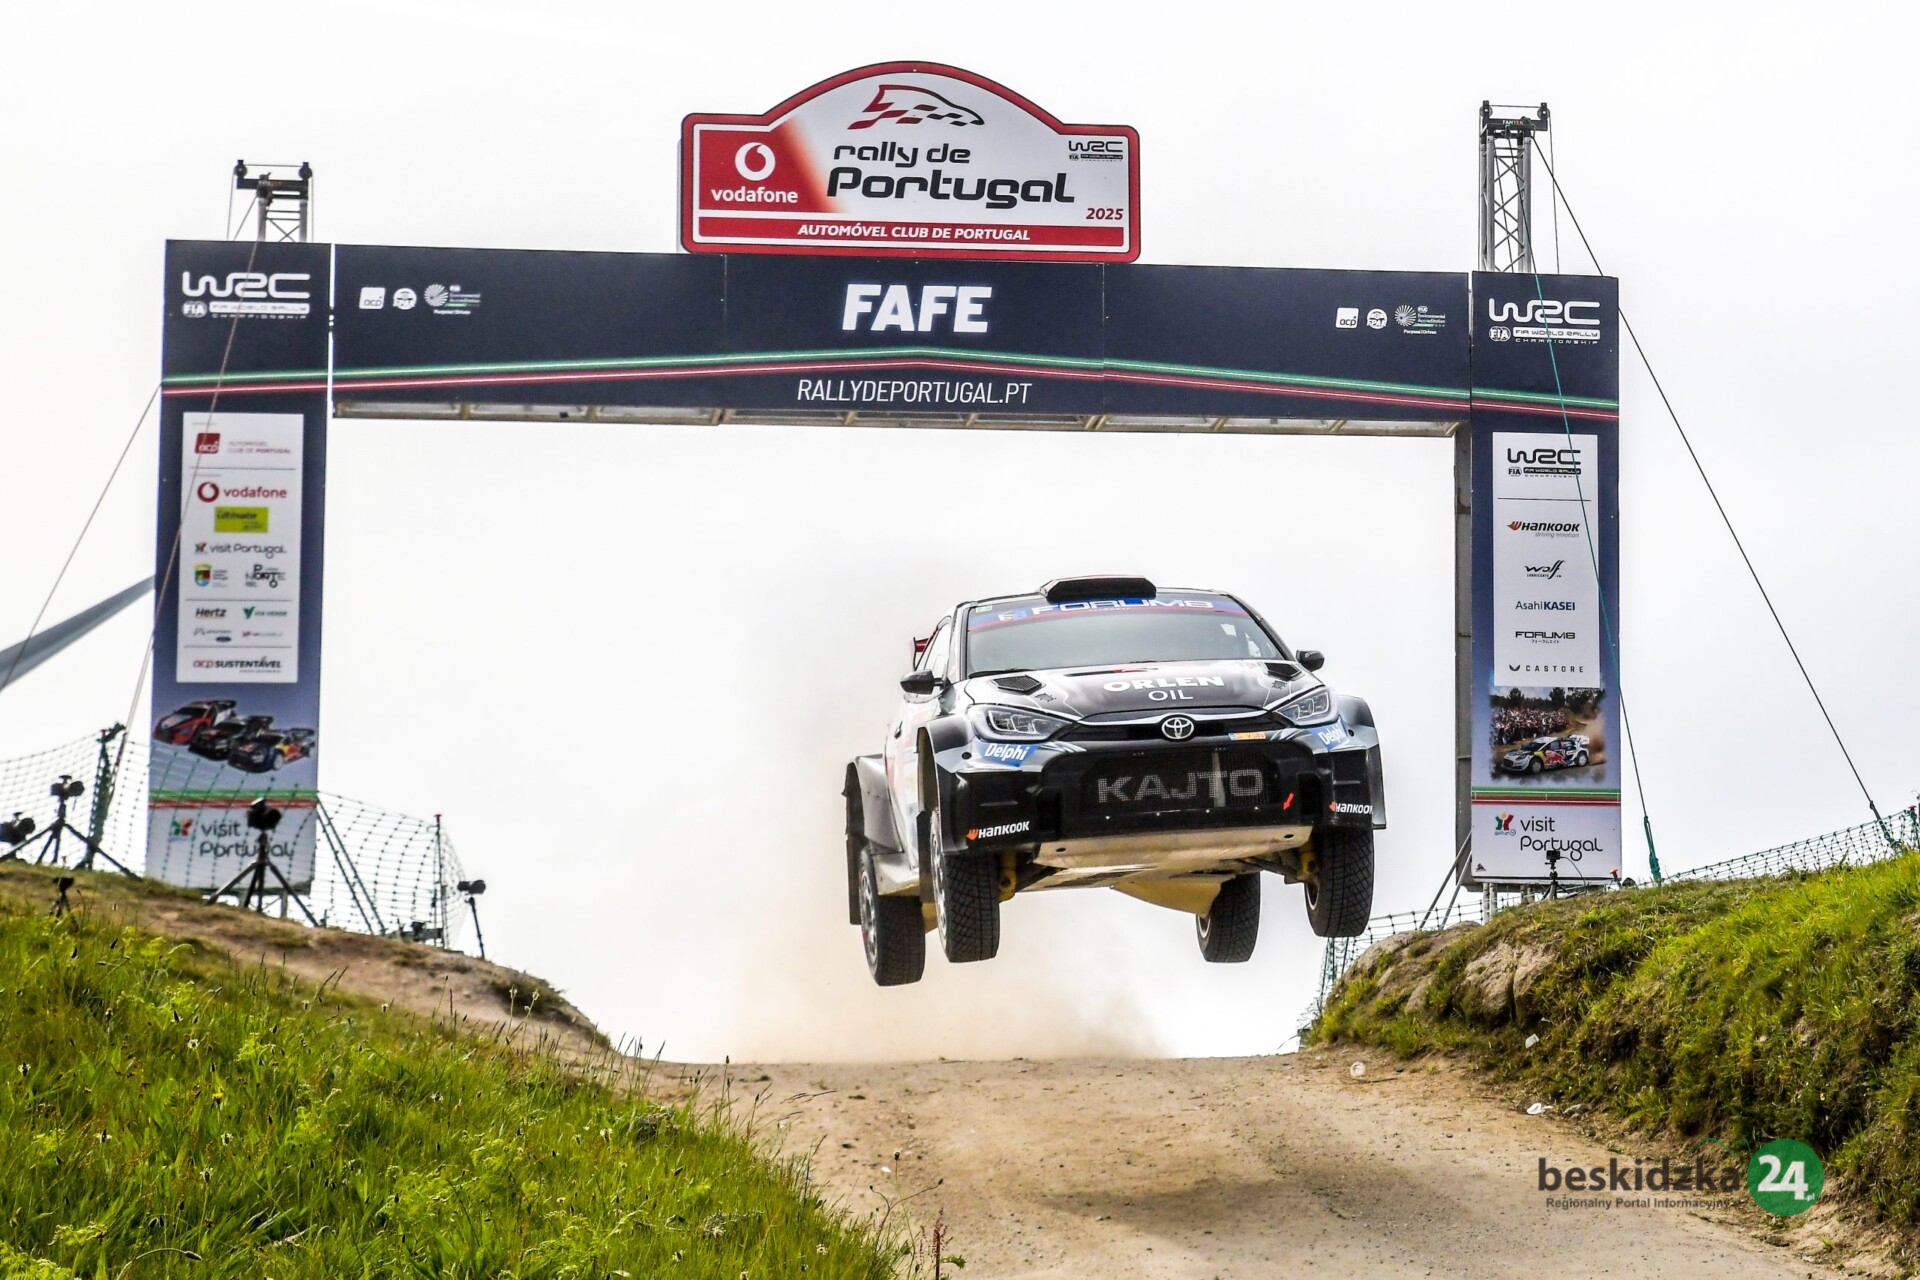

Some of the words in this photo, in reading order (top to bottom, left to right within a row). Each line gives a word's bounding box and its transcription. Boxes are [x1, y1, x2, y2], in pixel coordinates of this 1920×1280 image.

[834, 142, 917, 168] rally
[927, 144, 970, 164] de
[1068, 140, 1123, 153] WRC
[711, 186, 798, 204] vodafone
[827, 171, 1074, 209] Portugal
[1086, 208, 1123, 220] 2025
[797, 222, 888, 238] AUTOMÓVEL
[891, 226, 929, 239] CLUB
[931, 227, 951, 239] DE
[954, 228, 1031, 241] PORTUGAL
[182, 271, 311, 299] WRC
[183, 304, 206, 315] FIA
[842, 283, 992, 333] FAFE
[1488, 298, 1600, 325] WRC
[1490, 328, 1509, 340] FIA
[797, 379, 1032, 404] RALLYDEPORTUGAL.PT
[1507, 448, 1581, 465] WRC
[223, 486, 287, 498] vodafone
[210, 543, 232, 553] visit
[233, 543, 287, 559] Portugal
[195, 608, 227, 617] Hertz
[1515, 631, 1576, 640] FORUM8
[1525, 665, 1584, 673] CASTORE
[1103, 676, 1225, 692] ORLEN
[1148, 690, 1194, 701] OIL
[984, 743, 1031, 761] Delphi
[1097, 768, 1264, 803] KAJTO
[201, 820, 241, 837] visit
[1520, 815, 1555, 832] visit
[200, 841, 293, 857] Portual
[1520, 835, 1603, 862] Portugal
